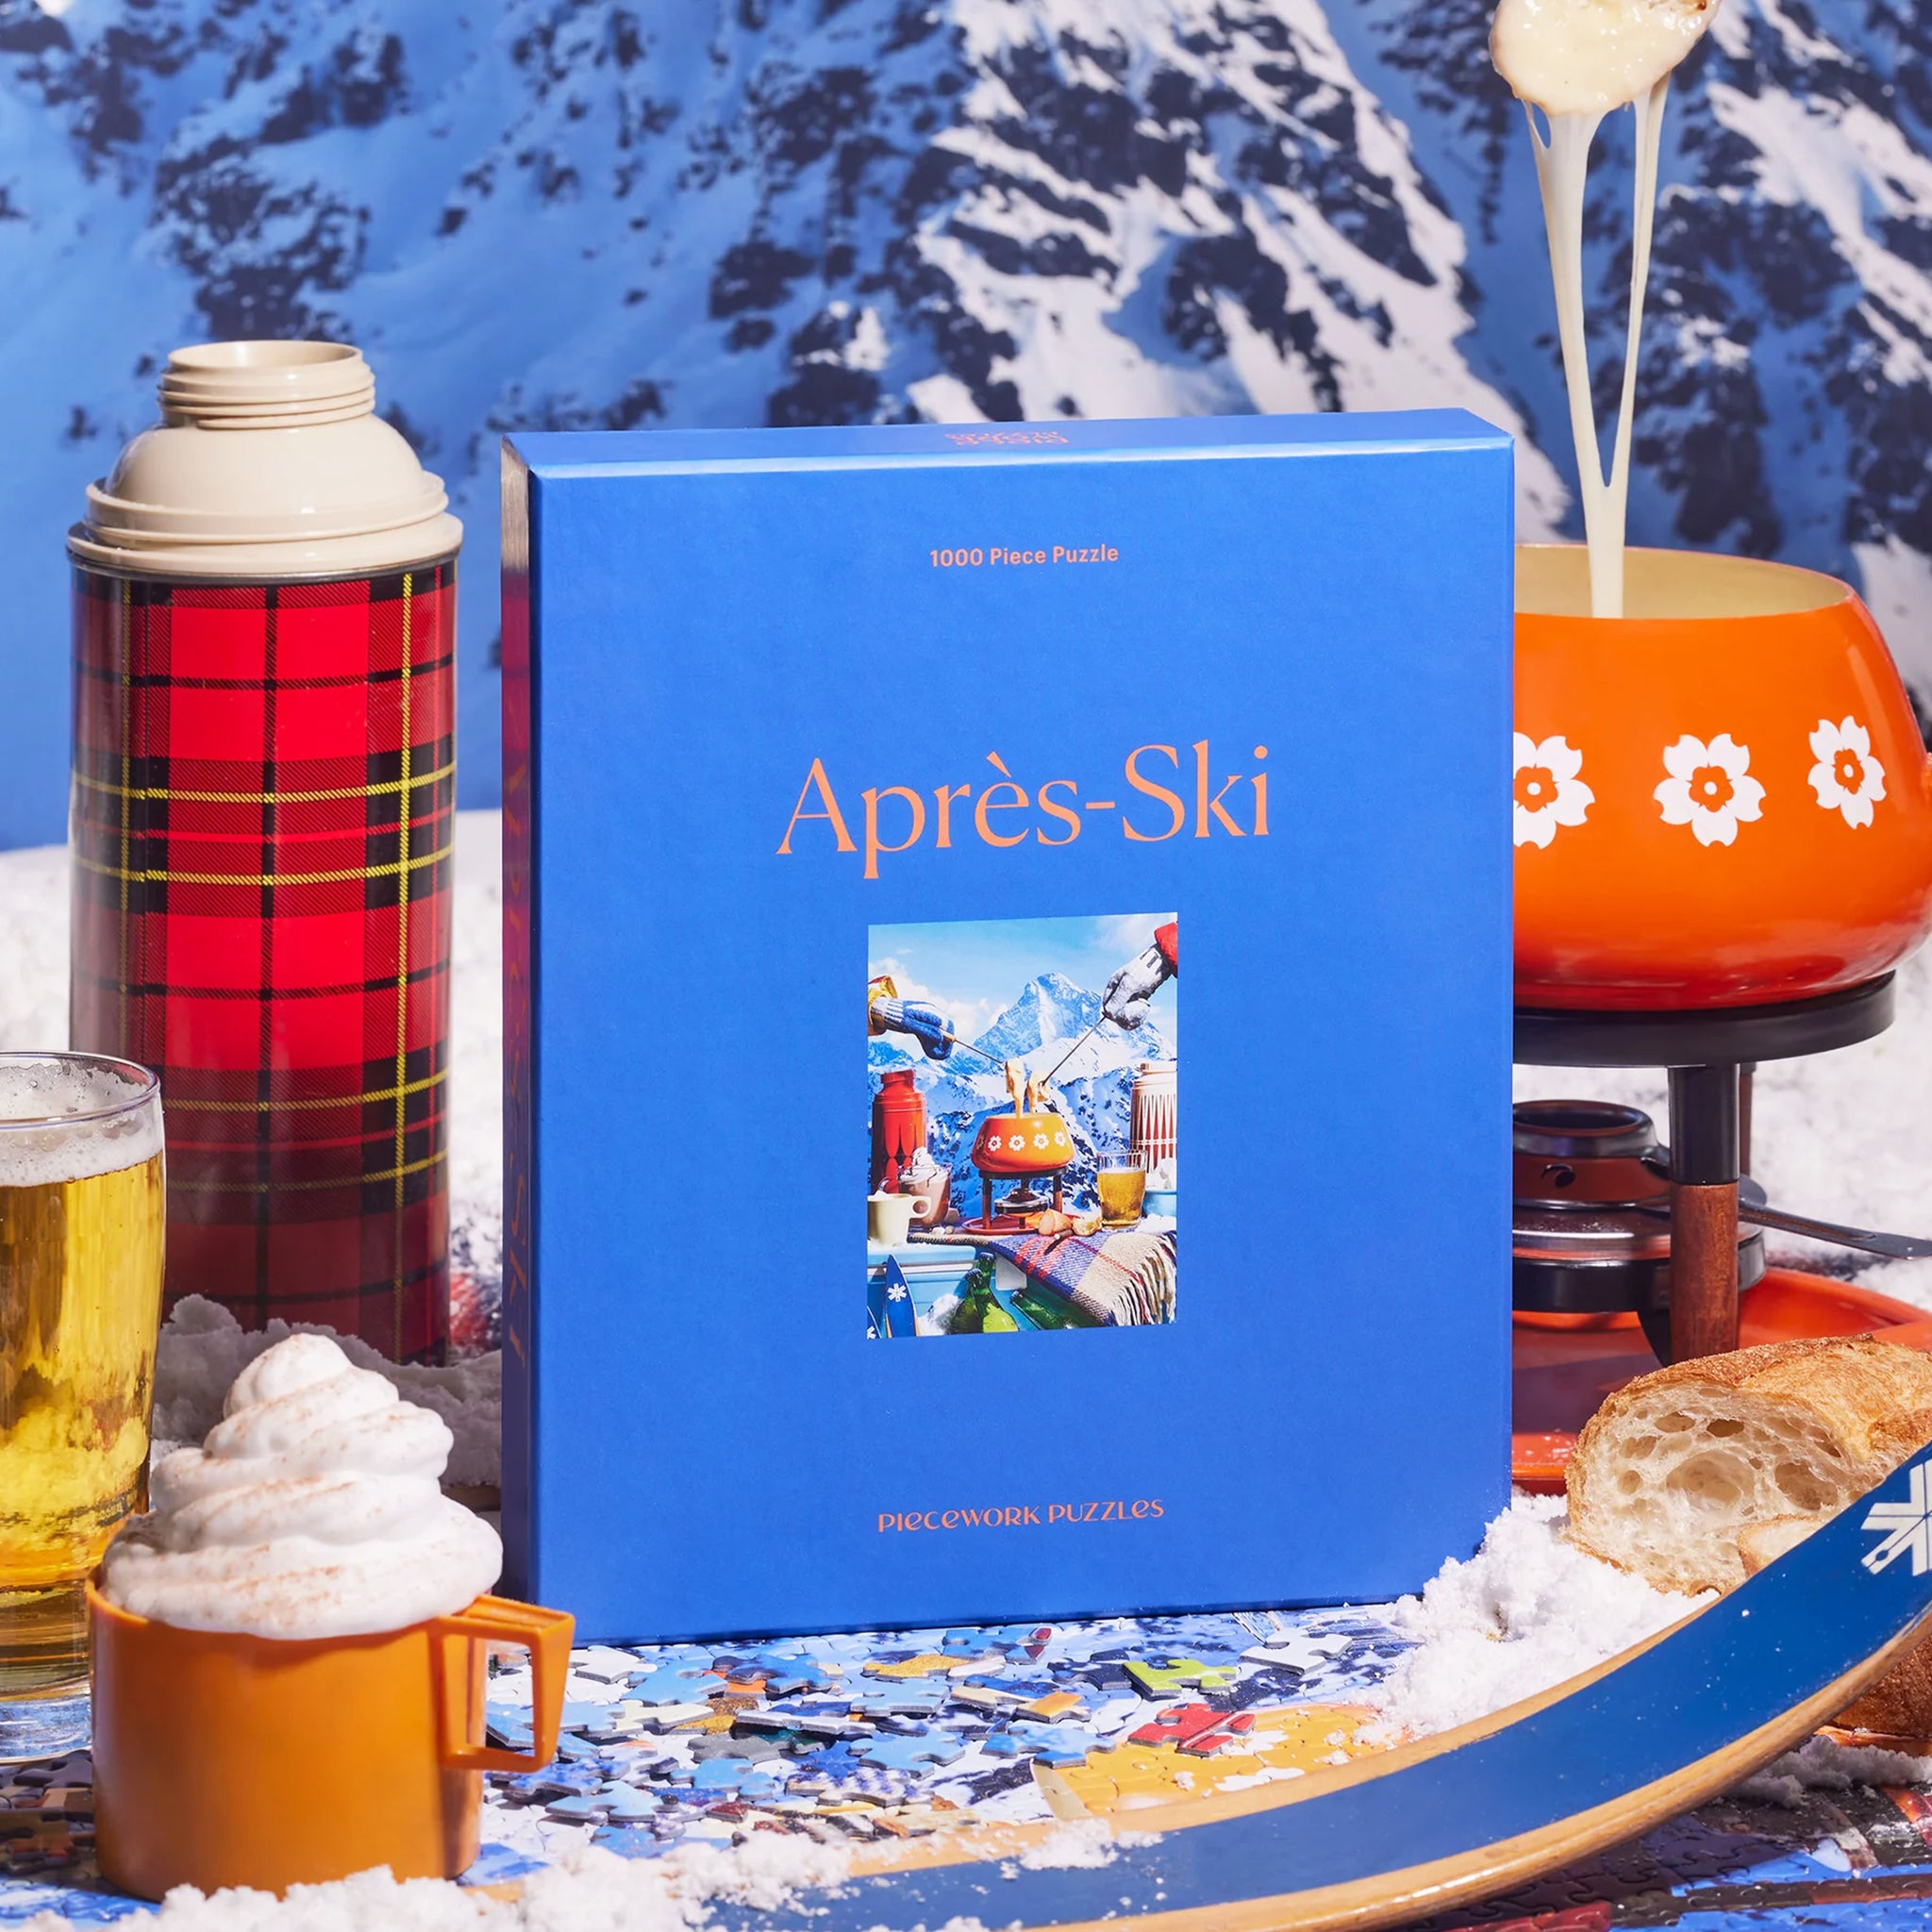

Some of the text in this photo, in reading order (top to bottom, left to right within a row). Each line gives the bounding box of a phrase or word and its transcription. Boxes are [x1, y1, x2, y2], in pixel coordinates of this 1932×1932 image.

[930, 543, 1119, 567] 1000 Piece Puzzle
[776, 739, 1270, 879] Après-Ski
